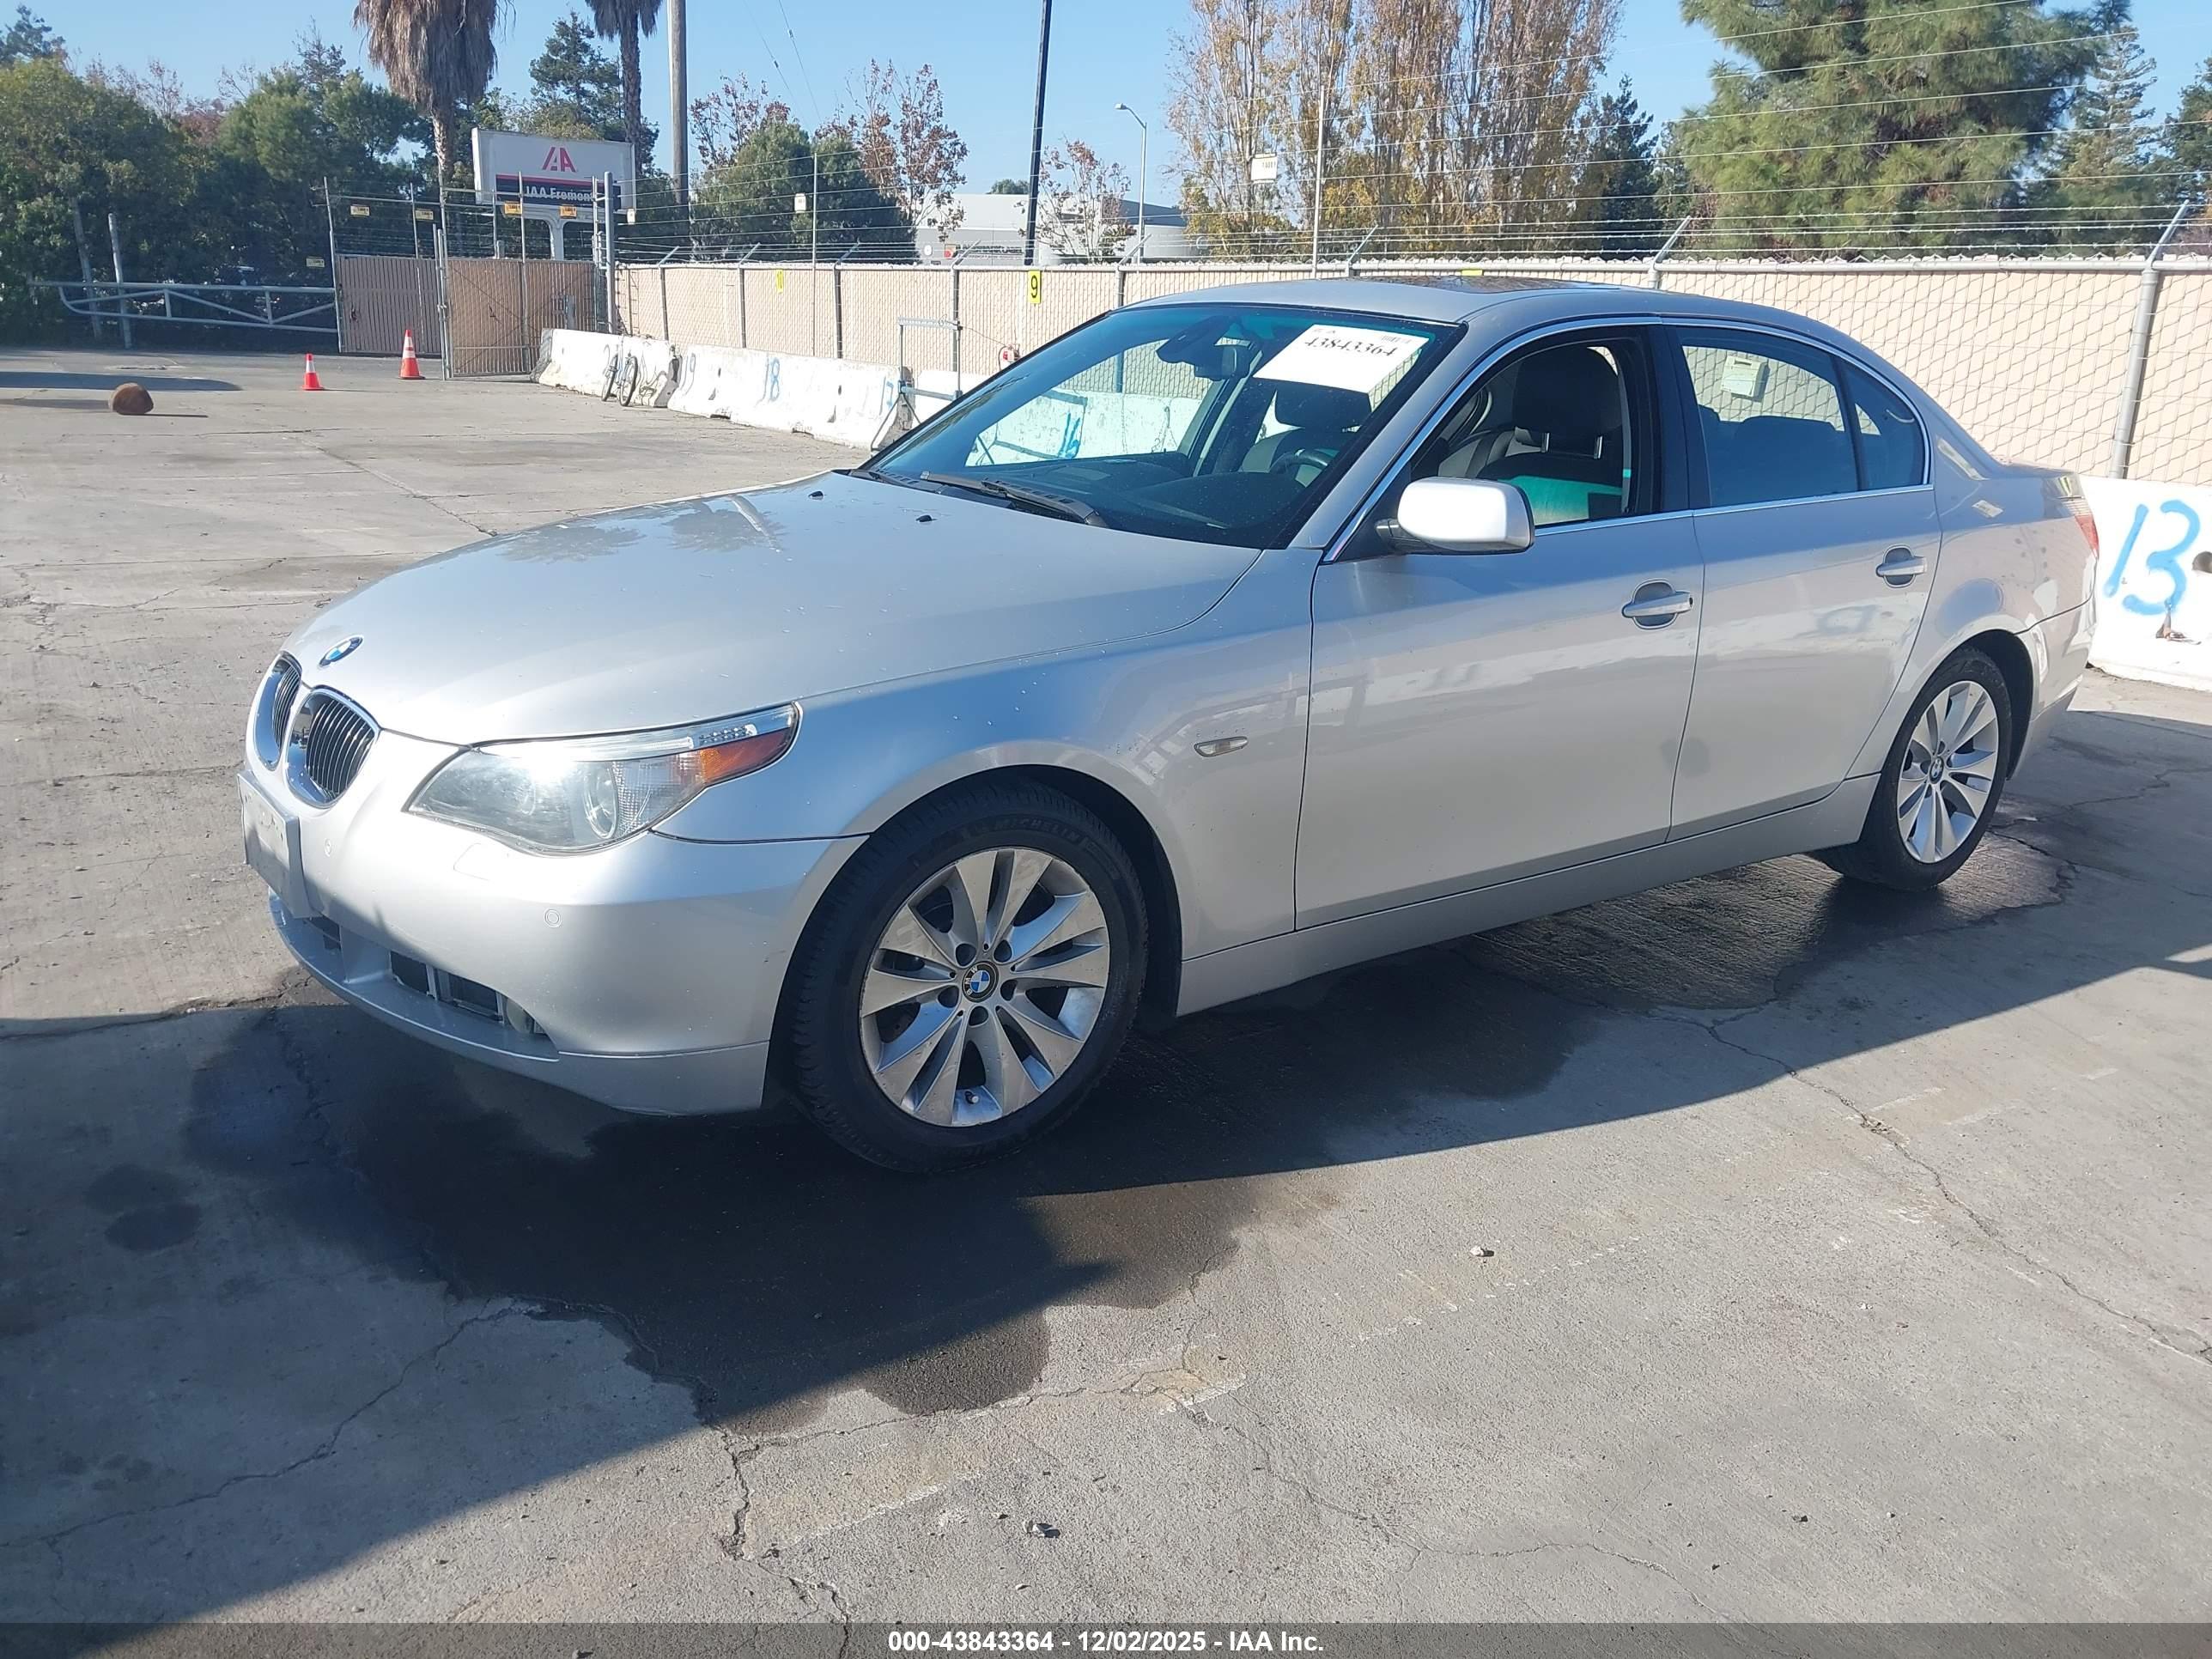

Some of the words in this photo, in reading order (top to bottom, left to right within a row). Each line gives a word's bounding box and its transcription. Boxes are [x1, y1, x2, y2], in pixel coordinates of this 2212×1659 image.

[1030, 275, 1038, 299] 9
[1304, 337, 1398, 356] 43843364
[2104, 500, 2200, 616] 13
[964, 965, 978, 996] BMW
